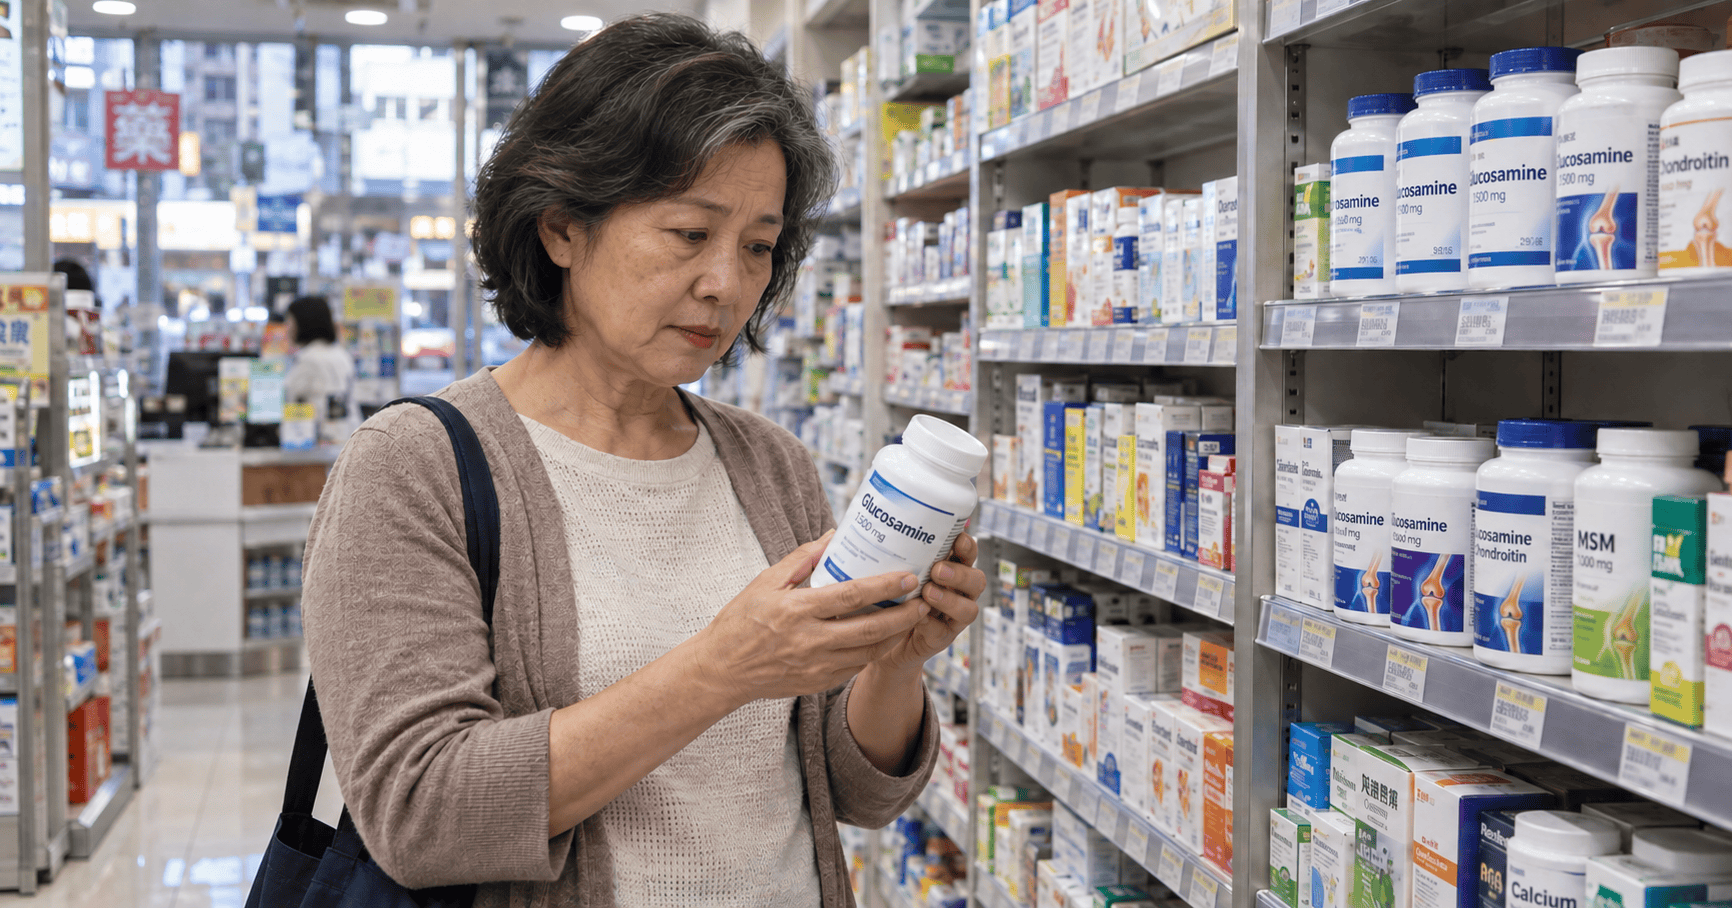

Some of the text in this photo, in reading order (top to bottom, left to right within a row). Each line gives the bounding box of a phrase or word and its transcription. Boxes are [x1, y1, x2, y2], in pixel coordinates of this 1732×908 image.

[1578, 173, 1595, 186] mg
[1490, 191, 1506, 203] mg
[1410, 205, 1422, 216] mg
[1349, 215, 1362, 227] mg
[862, 492, 936, 545] Glucosamine
[855, 511, 873, 531] 1500
[871, 528, 886, 544] mg
[1348, 529, 1360, 541] mg
[1578, 529, 1615, 553] MSM
[1407, 536, 1422, 548] mg
[1596, 559, 1613, 574] mg
[1511, 881, 1577, 908] Calcium
